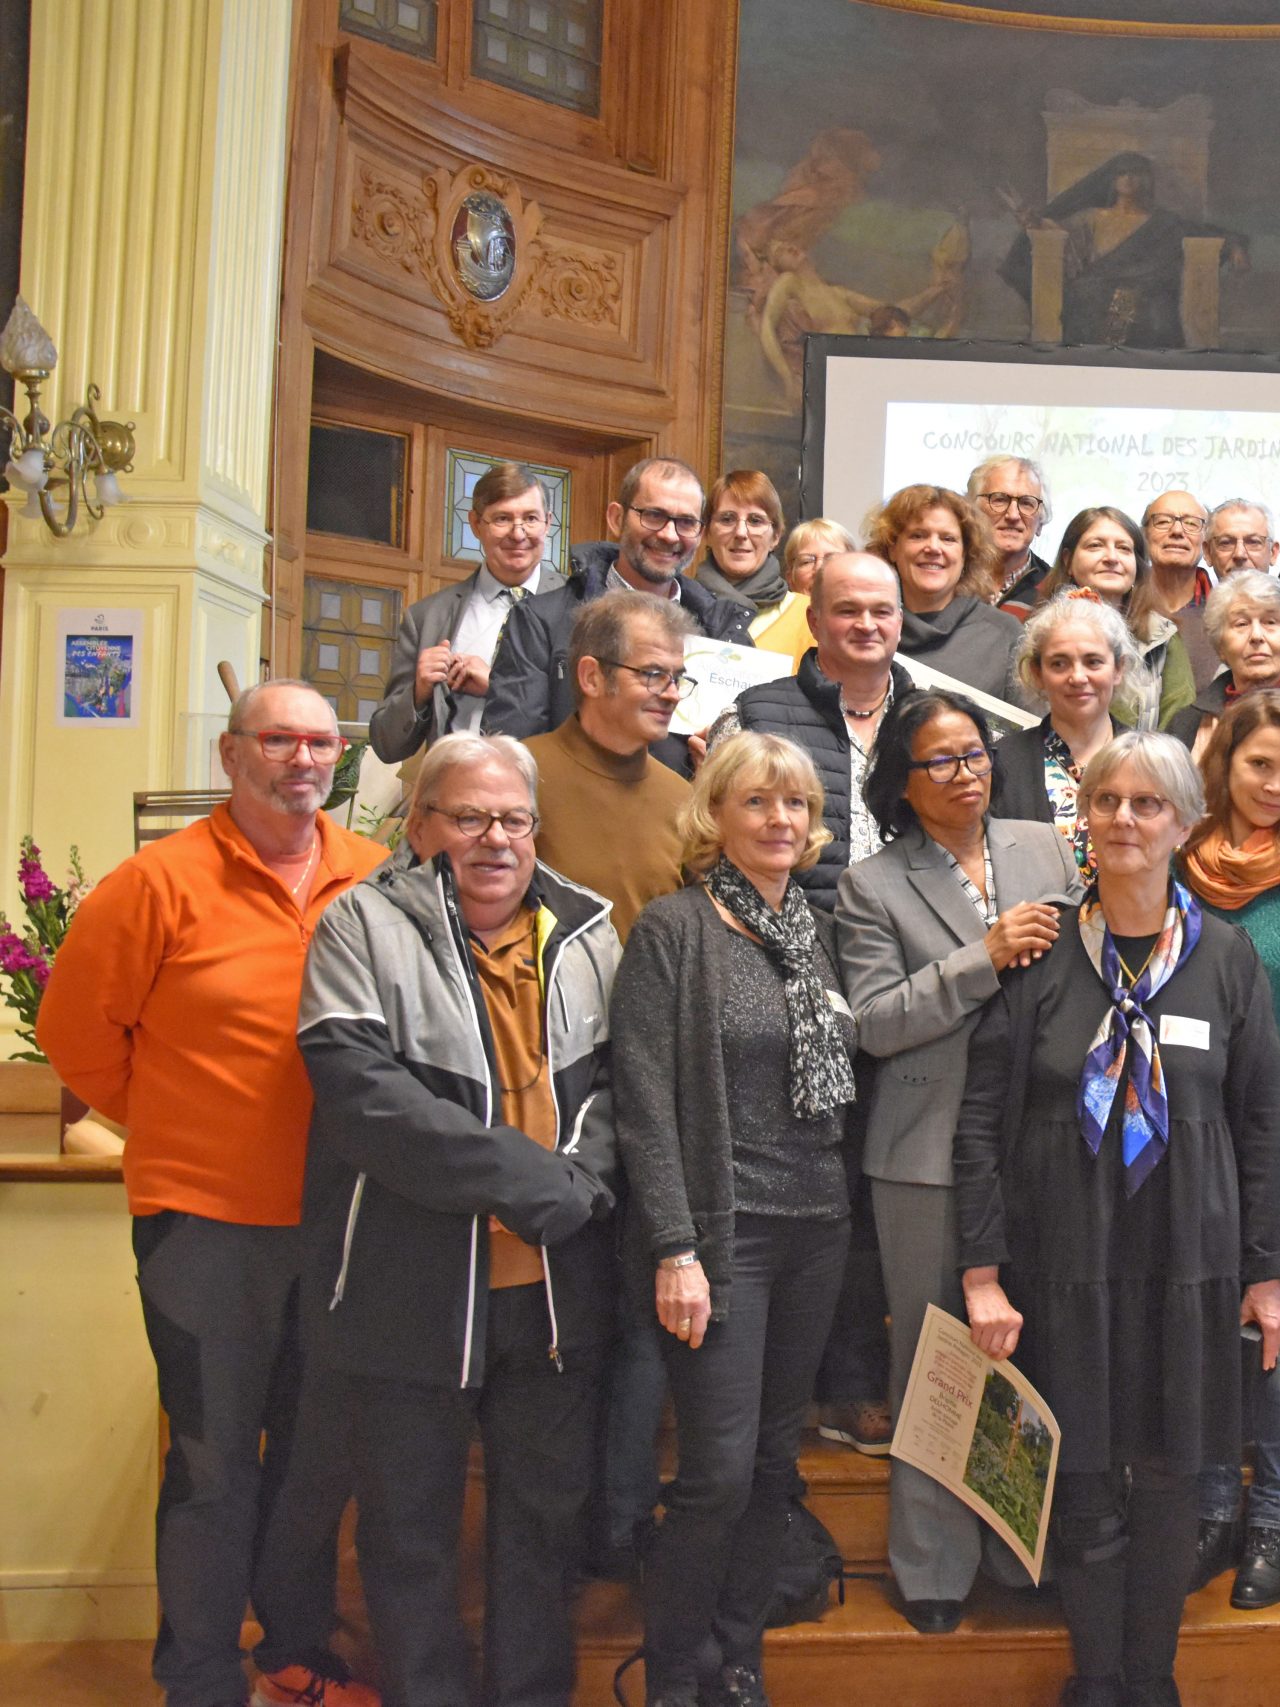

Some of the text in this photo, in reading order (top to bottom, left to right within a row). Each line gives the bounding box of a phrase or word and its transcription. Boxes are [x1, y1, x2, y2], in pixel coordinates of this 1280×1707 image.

[923, 431, 1035, 454] CONCOURS
[1046, 433, 1153, 457] NATIONAL
[1163, 436, 1197, 456] DES
[1137, 471, 1189, 492] 2023
[927, 1371, 956, 1395] Grand
[956, 1388, 974, 1408] Prix
